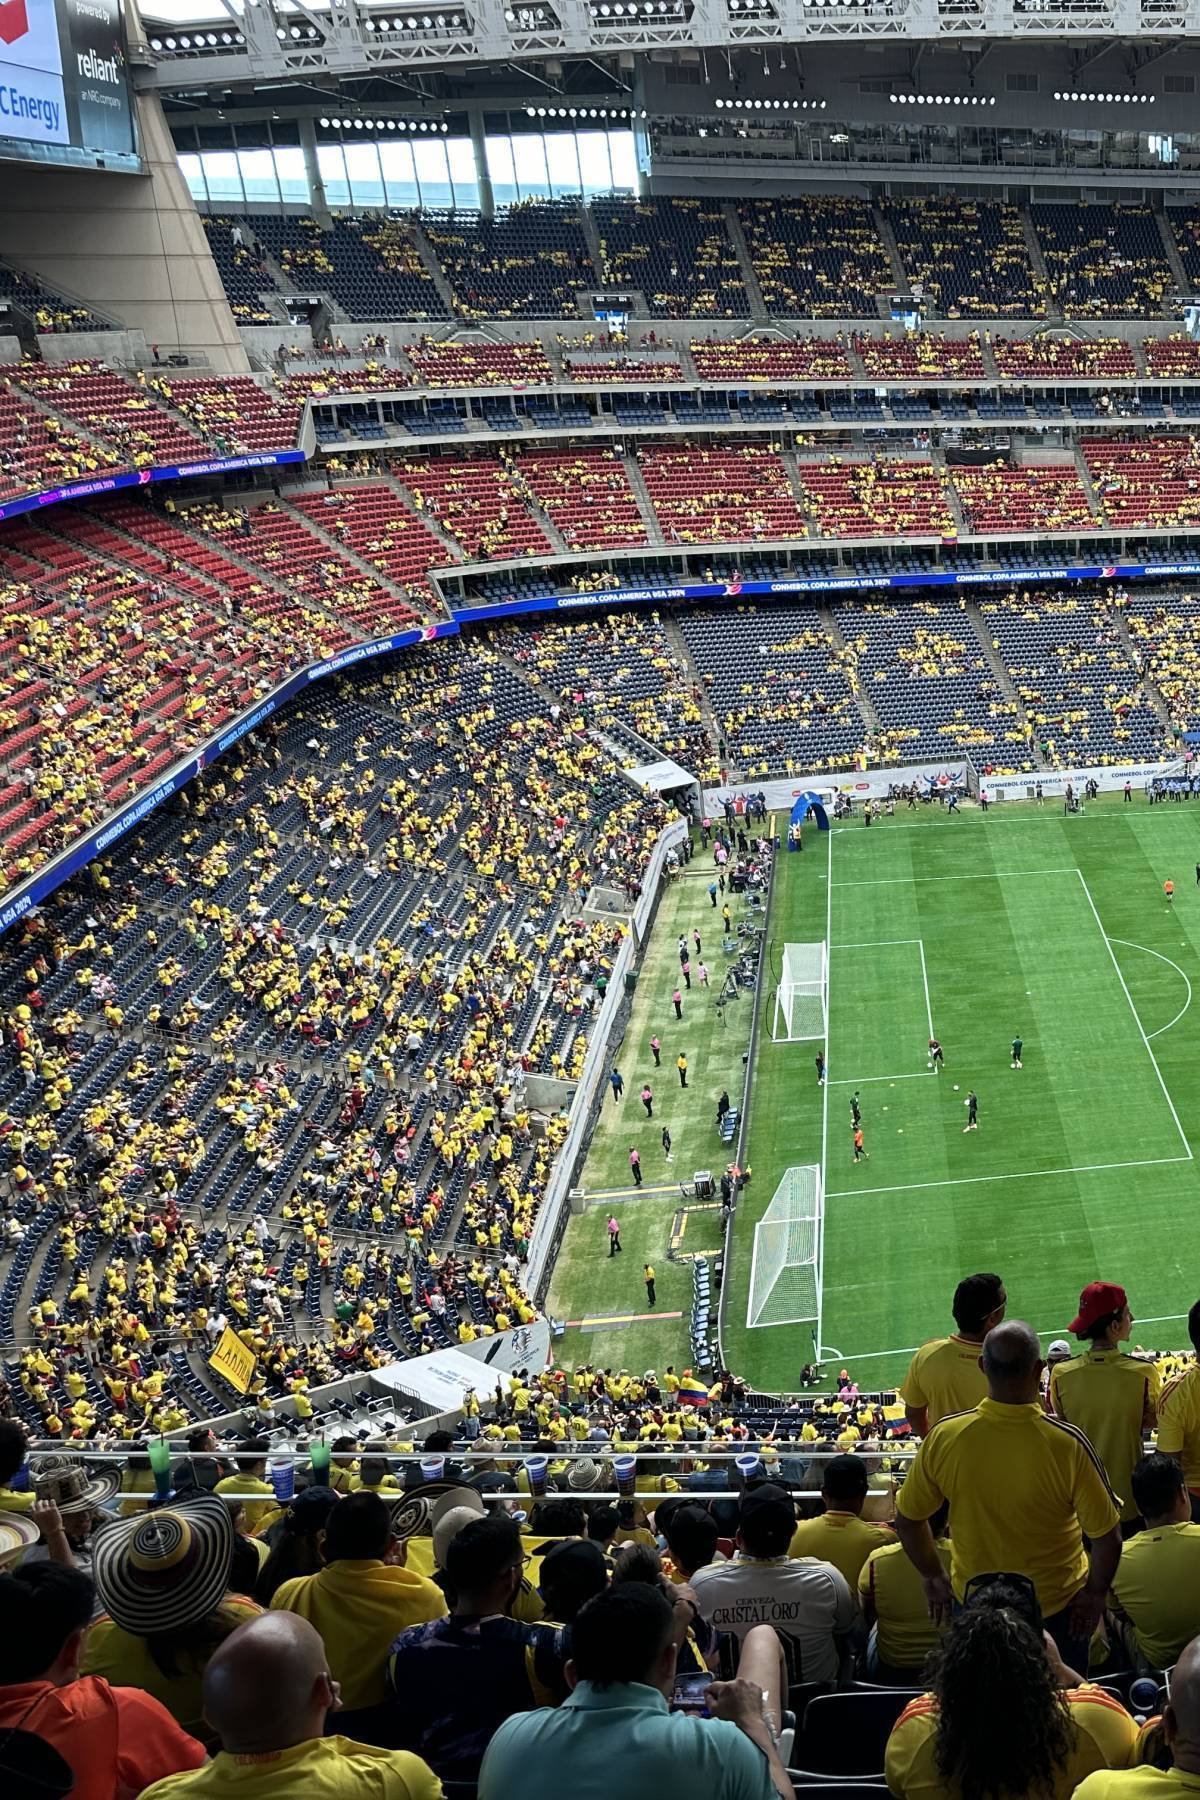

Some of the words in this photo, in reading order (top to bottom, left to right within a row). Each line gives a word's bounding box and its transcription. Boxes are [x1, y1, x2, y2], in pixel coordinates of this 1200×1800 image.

[76, 3, 102, 19] powered
[103, 9, 110, 24] by
[77, 48, 120, 85] reliant
[10, 87, 59, 131] Energy
[88, 90, 99, 104] NRG
[99, 95, 121, 110] company
[771, 582, 810, 591] CONMEBOL
[860, 579, 873, 587] USA
[956, 574, 992, 582] CONMEBOL
[558, 596, 599, 606] CONMEBOL
[599, 594, 618, 602] COPA
[618, 592, 651, 601] AMERICA
[652, 590, 666, 599] USA
[667, 589, 685, 597] 2024
[736, 1596, 776, 1606] CERVEZA
[712, 1605, 770, 1624] CRISTAL
